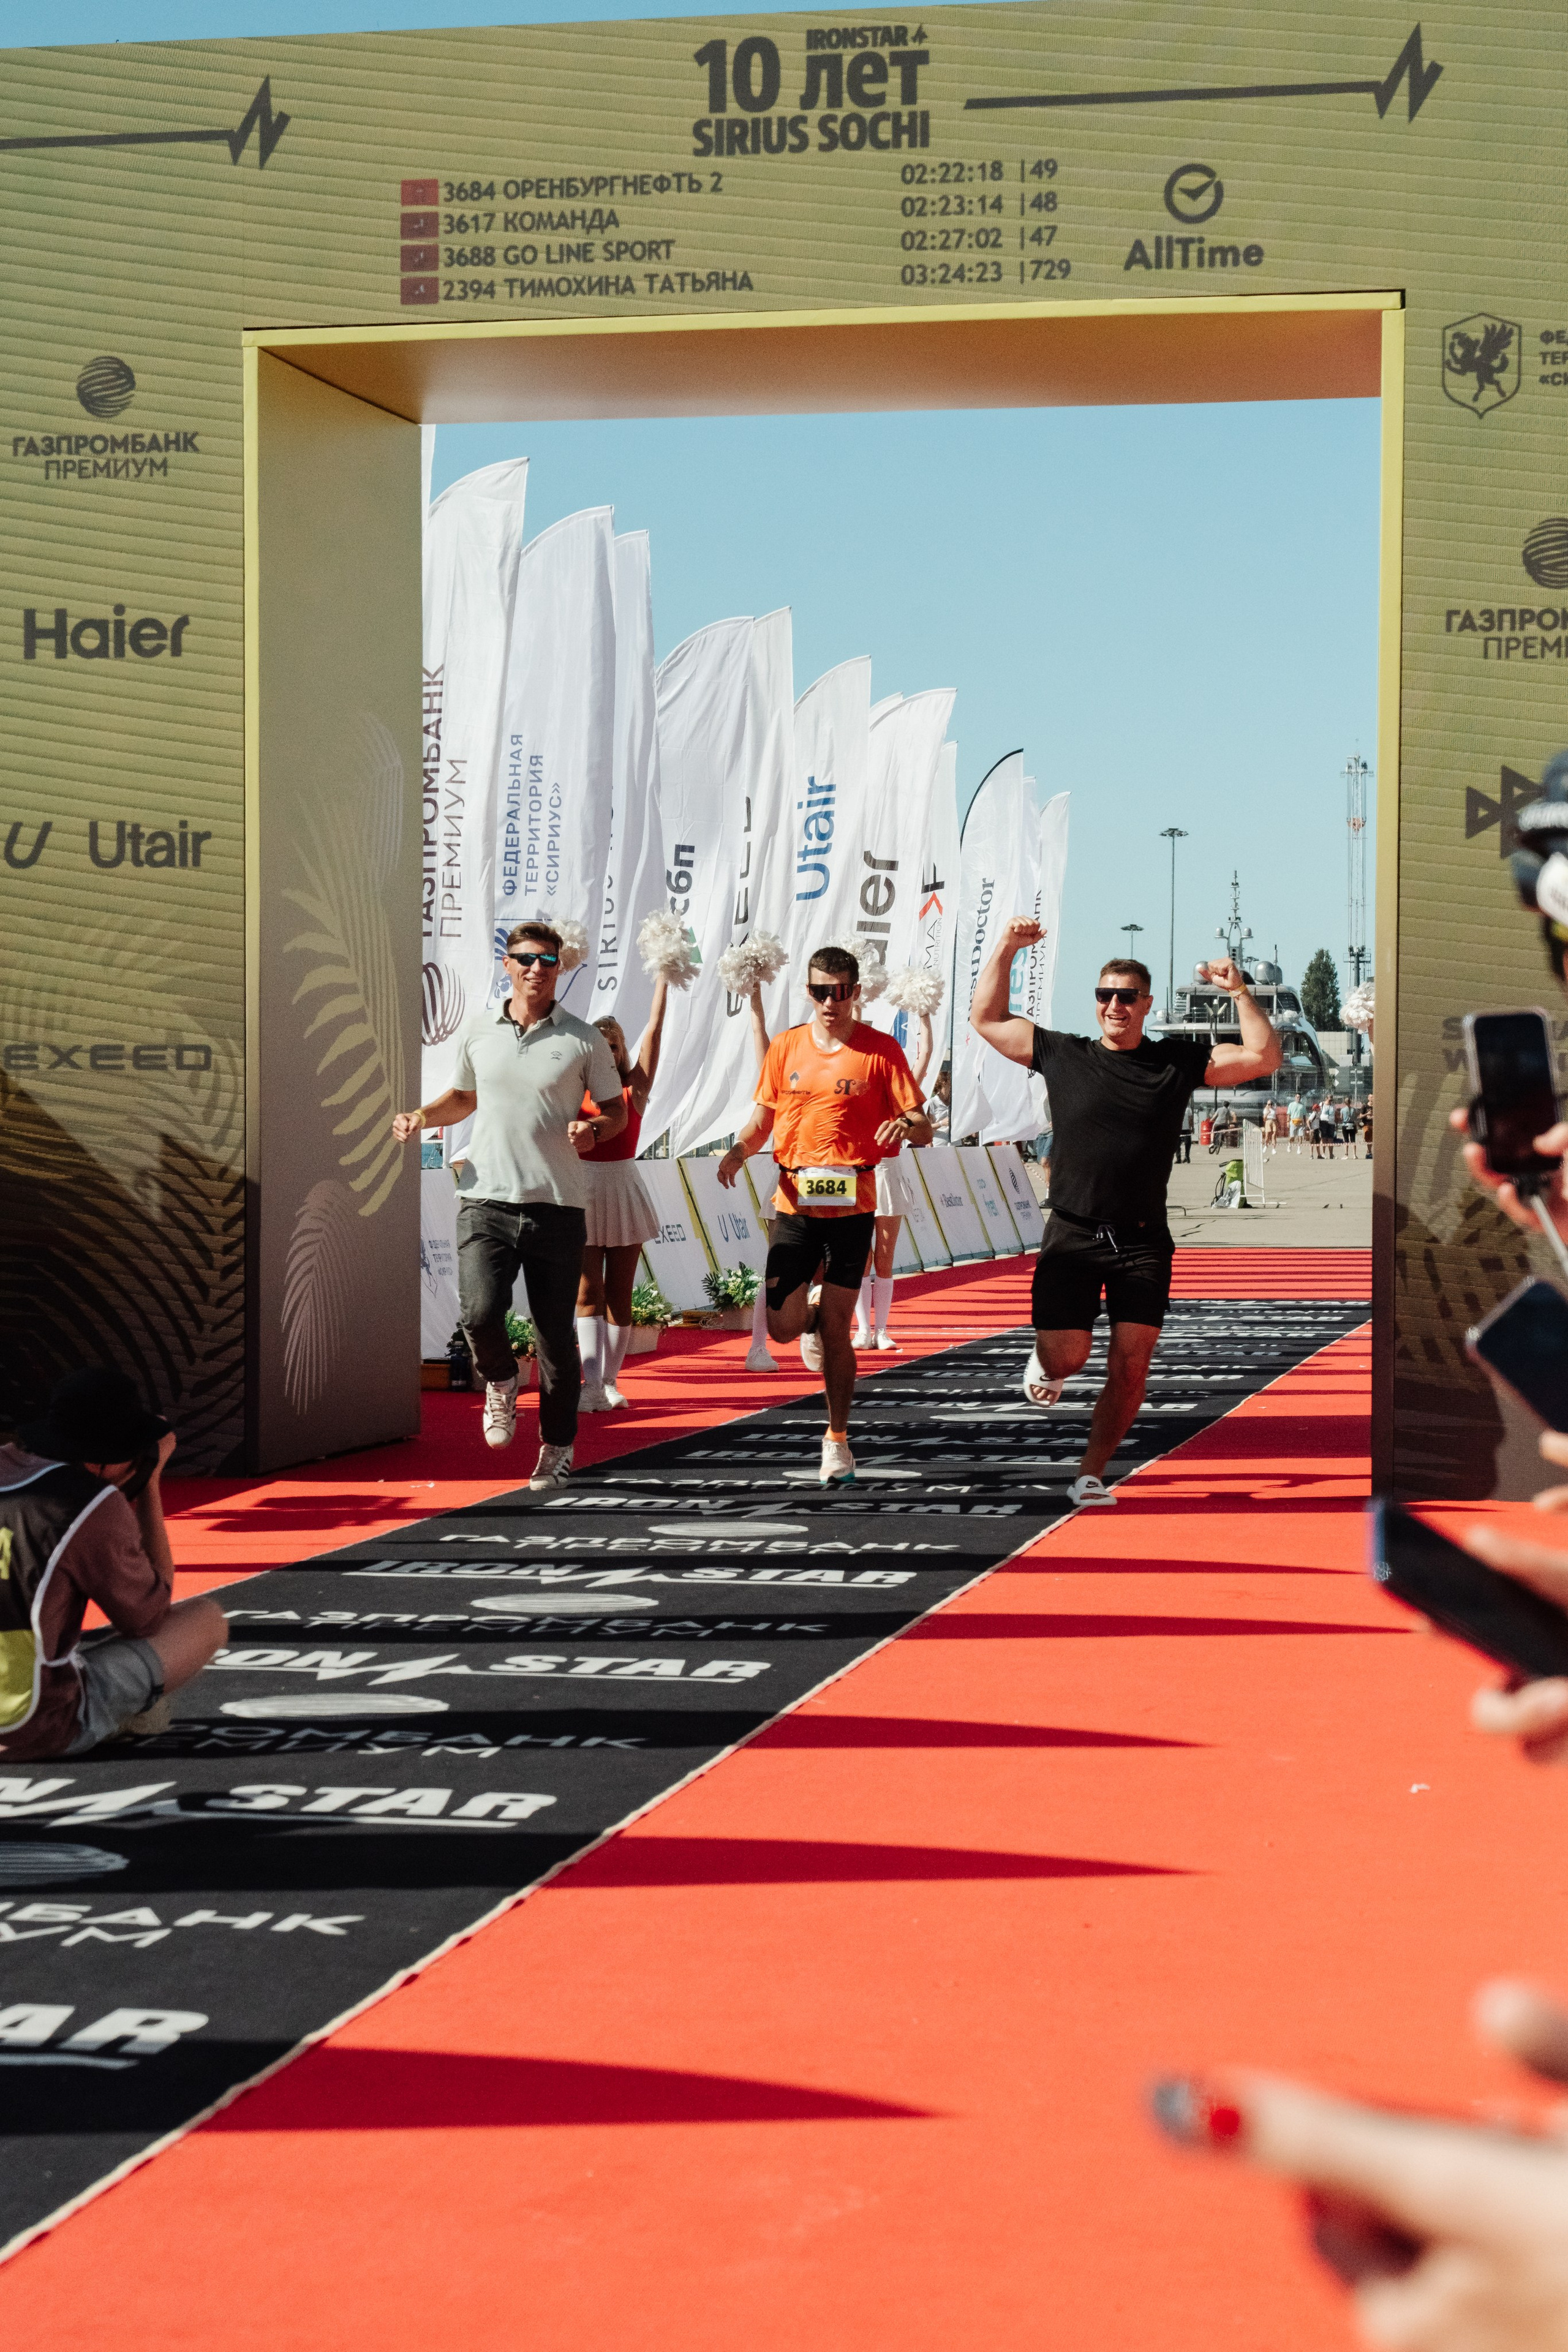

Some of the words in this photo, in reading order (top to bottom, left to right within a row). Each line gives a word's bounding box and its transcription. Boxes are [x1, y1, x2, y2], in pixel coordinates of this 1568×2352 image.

[805, 25, 908, 50] IRONSTAR
[693, 36, 781, 114] 10
[799, 50, 930, 111] лет
[692, 115, 810, 157] SIRIUS
[818, 110, 930, 153] SOCHI
[900, 161, 1003, 184] 02:22:18
[443, 181, 496, 203] 3684
[503, 172, 703, 200] ОРЕНБУРГНЕФТЬ
[710, 171, 723, 194] 2
[900, 194, 1003, 218] 02:23:14
[443, 212, 496, 235] 3617
[503, 208, 620, 235] КОМАНДА
[443, 246, 496, 266] 3688
[503, 244, 538, 266] GO
[545, 242, 594, 265] LINE
[603, 239, 676, 263] SPORT
[900, 227, 1003, 252] 02:27:02
[1123, 235, 1265, 272] AllTime
[443, 281, 496, 302] 2394
[506, 274, 636, 299] ТИМОХИНА
[644, 270, 753, 298] ТАТЬЯНА
[900, 261, 1003, 285] 03:24:23
[12, 431, 200, 457] ГАЗПРОМБАНК
[45, 457, 168, 481] ПРЕМИУМ
[23, 604, 190, 660] Haier
[502, 734, 523, 896] ФЕДЕРАЛЬНАЯ
[525, 755, 543, 896] ТЕРРИТОРИЯ
[88, 820, 212, 869] Utair
[440, 758, 467, 938] ПРЕМИУМ
[546, 782, 562, 896] «СИРИУС»
[796, 775, 837, 902] Utair
[932, 917, 943, 967] NUTRITION
[4, 1044, 213, 1071] EXEED
[806, 1179, 847, 1195] 3684
[543, 1497, 735, 1509] IRON
[439, 1534, 958, 1550] ГАЗПРОМБАНК
[358, 1560, 584, 1576] IRON
[681, 1567, 915, 1584] STAR
[222, 1610, 829, 1632] ГАЗПРОМБАНК
[489, 1654, 771, 1678] STAR
[205, 1784, 557, 1819] STAR
